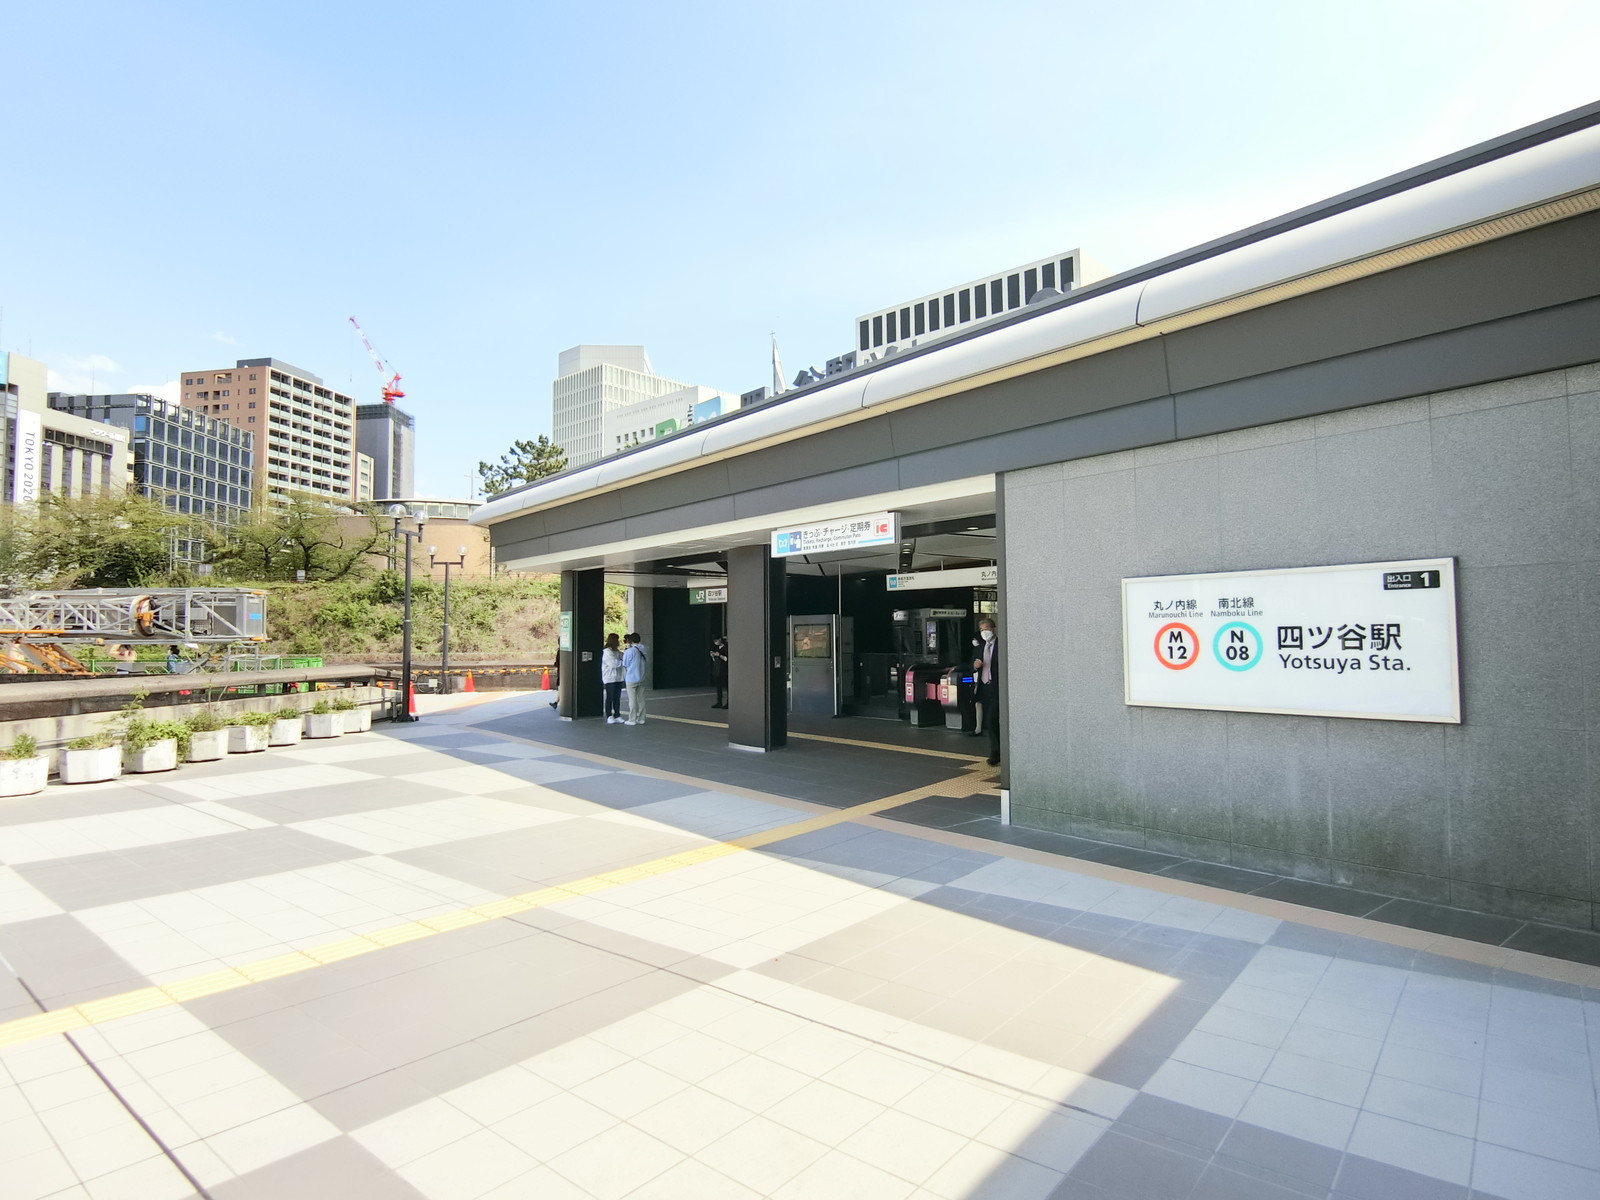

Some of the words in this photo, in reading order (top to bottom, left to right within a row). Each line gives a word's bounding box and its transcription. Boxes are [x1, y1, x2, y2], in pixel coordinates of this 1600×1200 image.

[24, 432, 36, 471] TOKYO
[1387, 574, 1411, 583] 出入口
[1420, 572, 1430, 587] 1
[696, 591, 705, 599] JR
[1153, 599, 1198, 611] 丸ノ内線
[1217, 597, 1255, 609] 南北線
[1148, 610, 1187, 619] Marunouchi
[1188, 610, 1204, 618] Line
[1210, 609, 1246, 617] Namboku
[1247, 608, 1264, 617] Line
[1169, 631, 1184, 644] M
[1230, 630, 1244, 644] N
[1277, 623, 1403, 651] 四ツ谷駅
[1168, 646, 1188, 660] 12
[1225, 645, 1250, 661] 08
[1278, 653, 1362, 675] Yotsuya
[1368, 654, 1411, 671] Sta.
